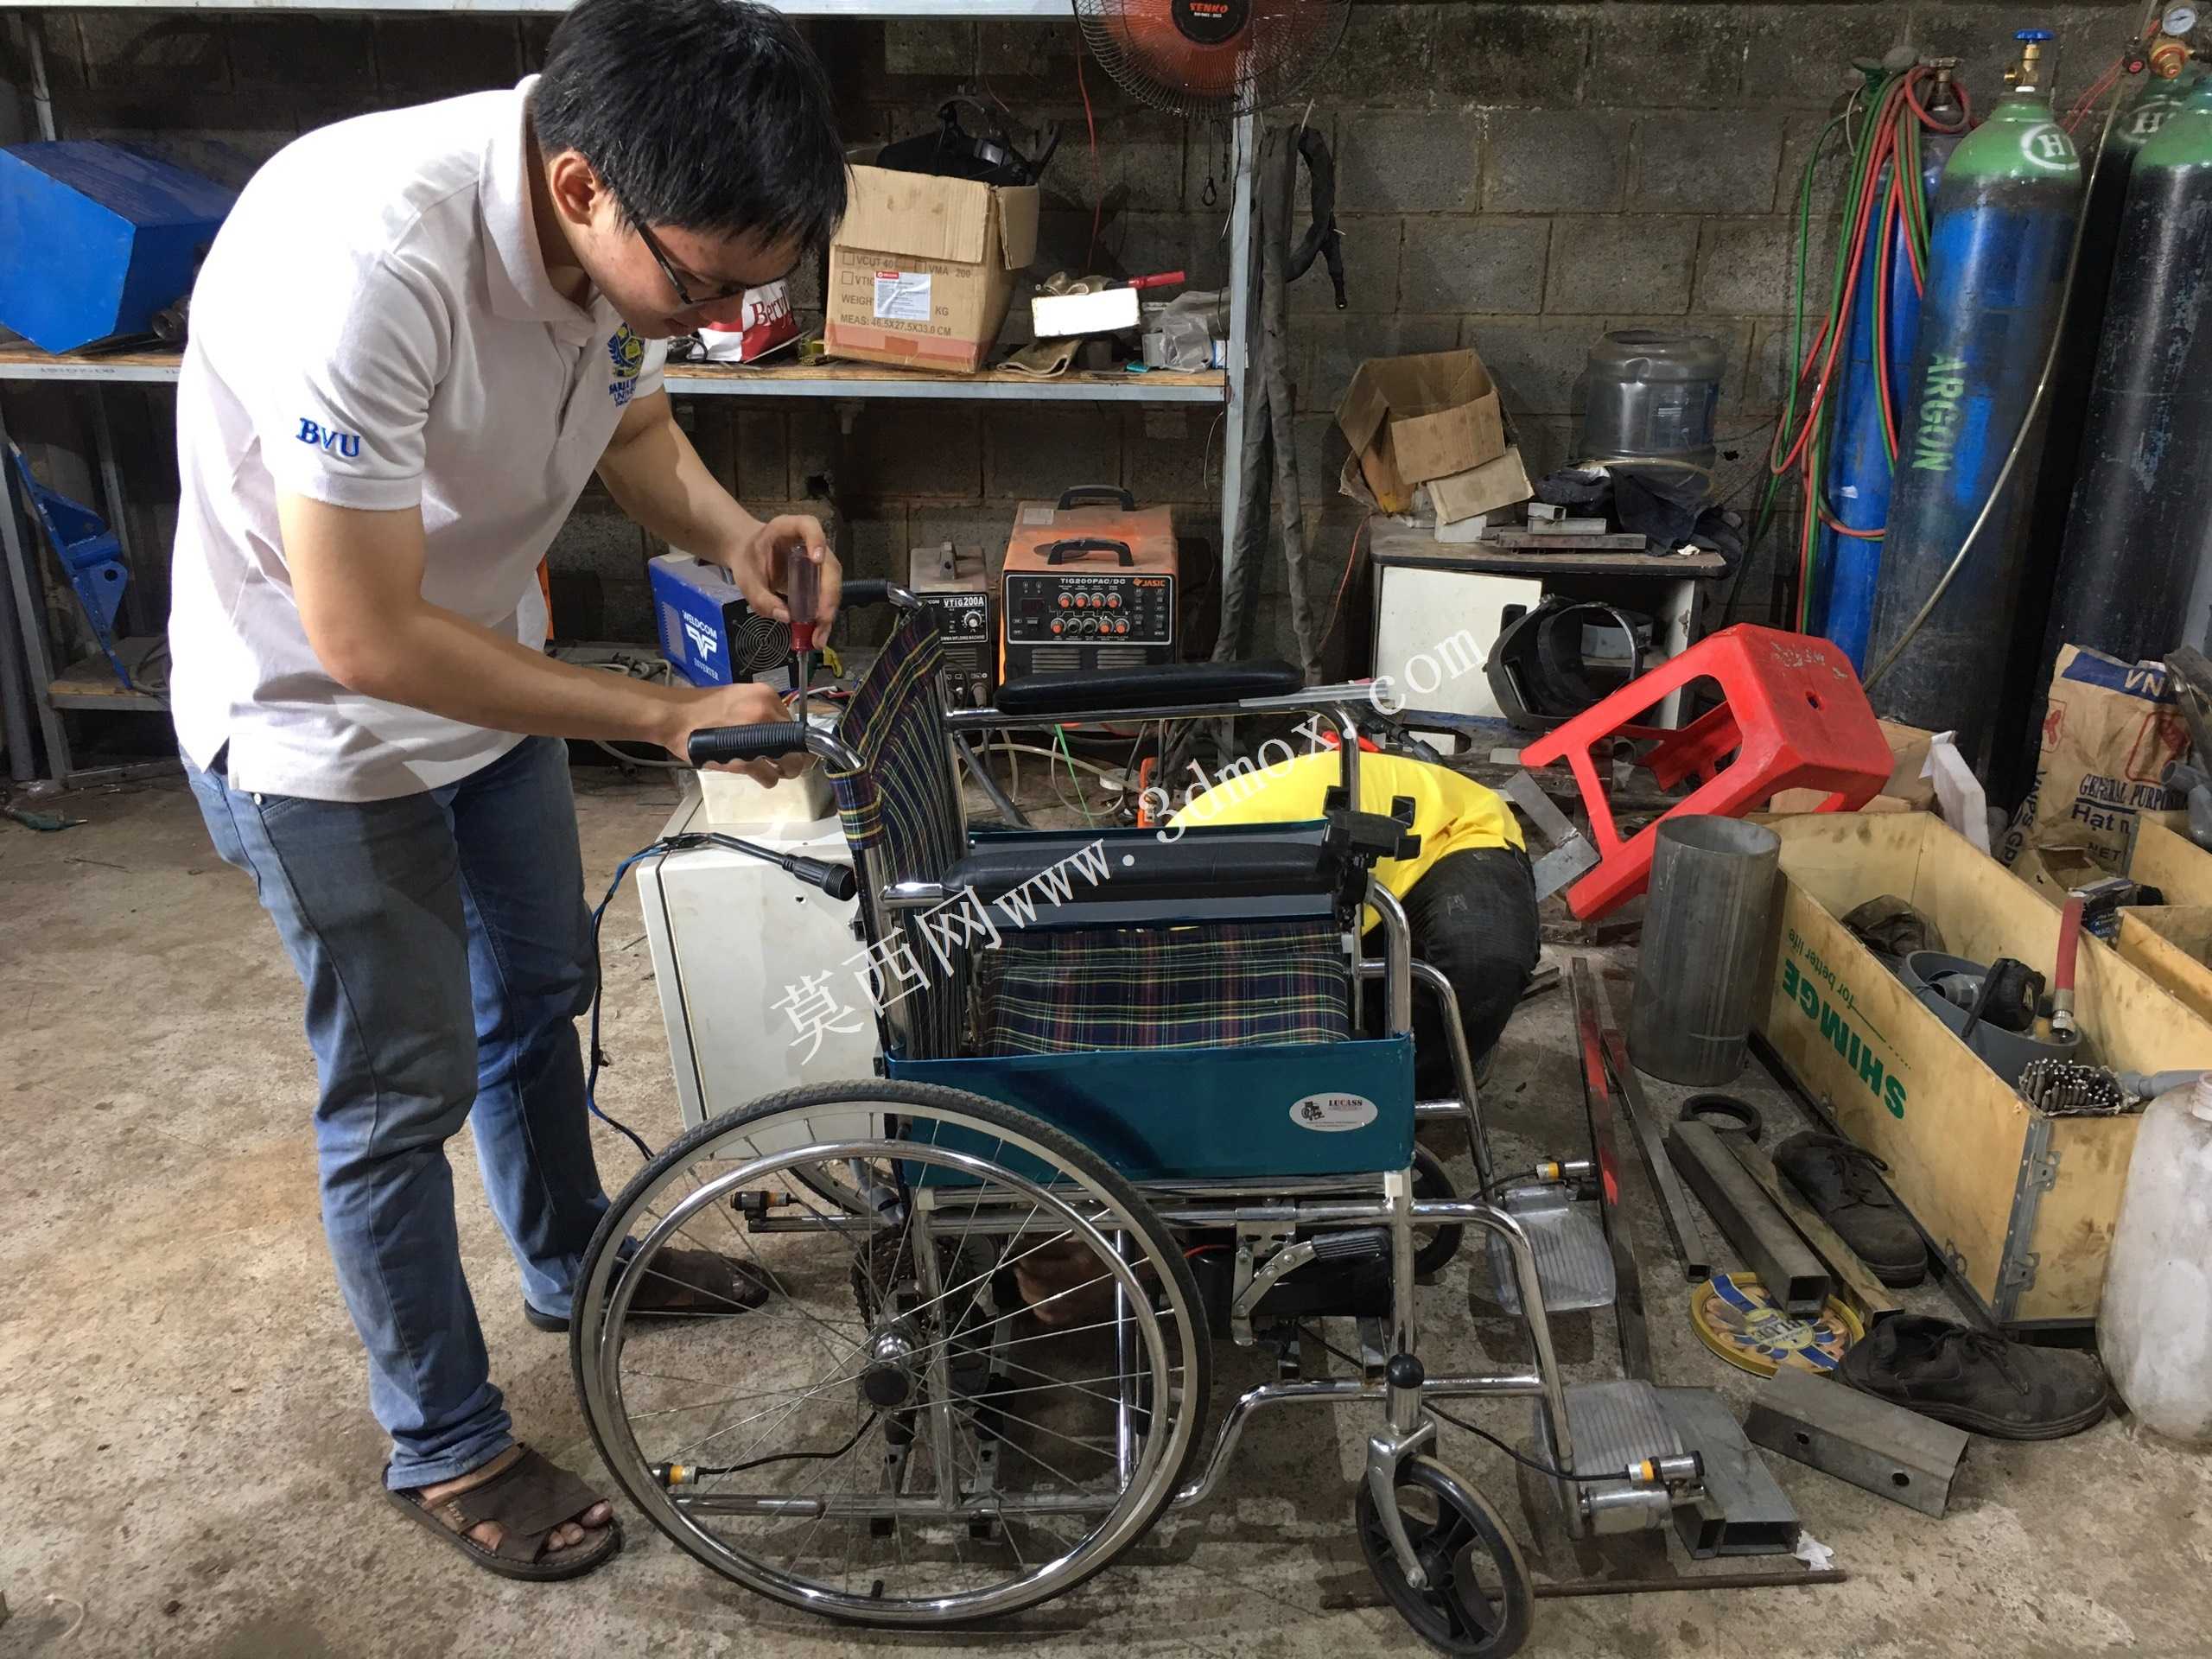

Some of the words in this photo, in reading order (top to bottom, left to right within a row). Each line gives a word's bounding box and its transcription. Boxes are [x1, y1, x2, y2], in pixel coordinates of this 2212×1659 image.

[955, 268, 971, 278] 200
[842, 293, 874, 307] WEIGH
[935, 305, 949, 317] KG
[937, 325, 951, 335] CM
[1911, 352, 1968, 471] ARGON
[296, 417, 360, 457] BVU
[1804, 947, 1836, 991] better
[1838, 982, 1855, 1010] for
[1782, 957, 1907, 1119] SHIMGE
